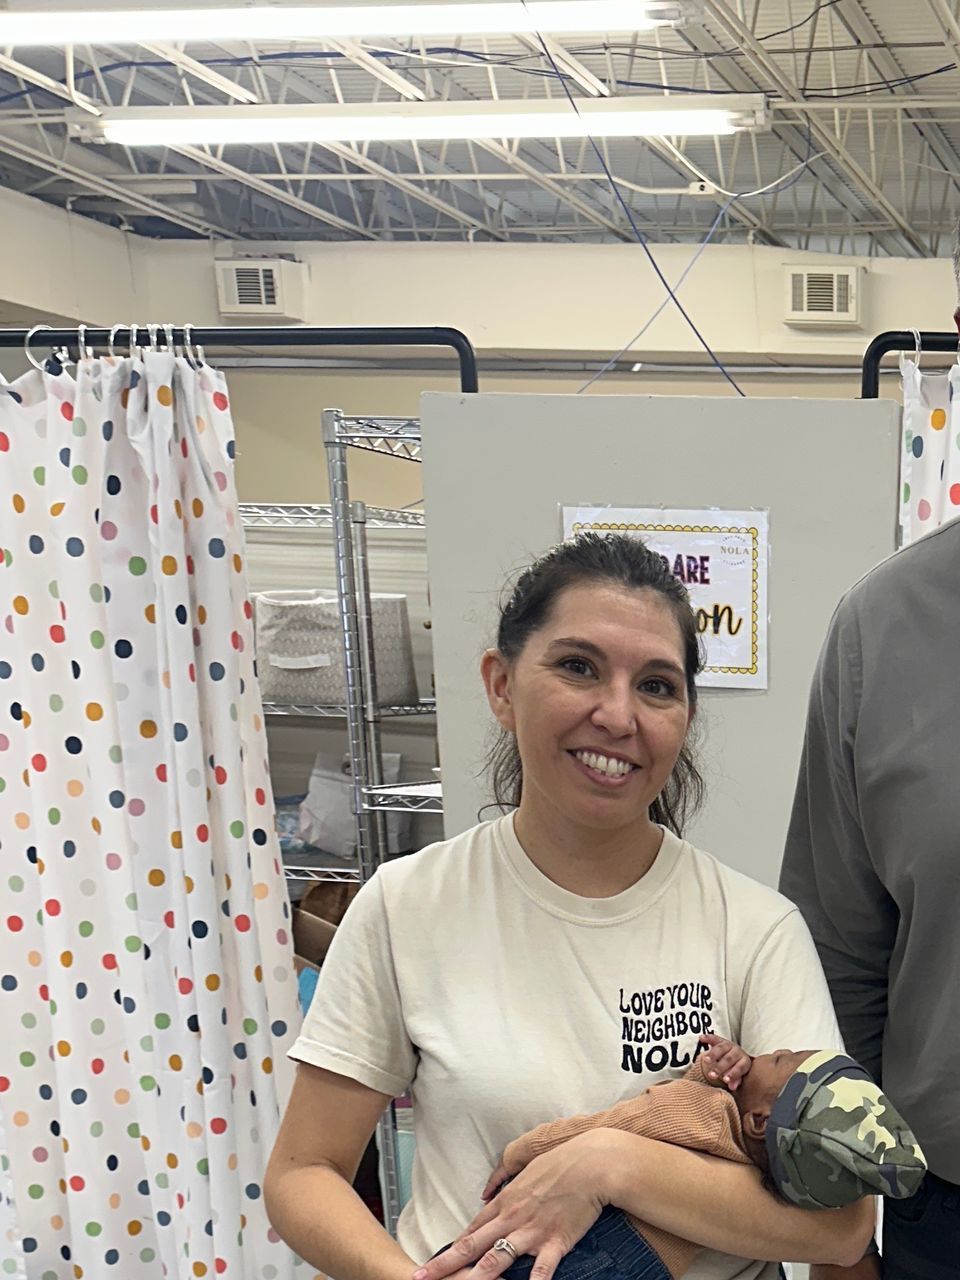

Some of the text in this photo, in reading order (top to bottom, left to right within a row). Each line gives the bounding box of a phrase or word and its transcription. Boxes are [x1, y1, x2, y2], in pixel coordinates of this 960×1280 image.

[720, 545, 750, 555] NOLA
[619, 982, 713, 1016] LOVE YOUR
[621, 1010, 715, 1043] NEIGHBOR
